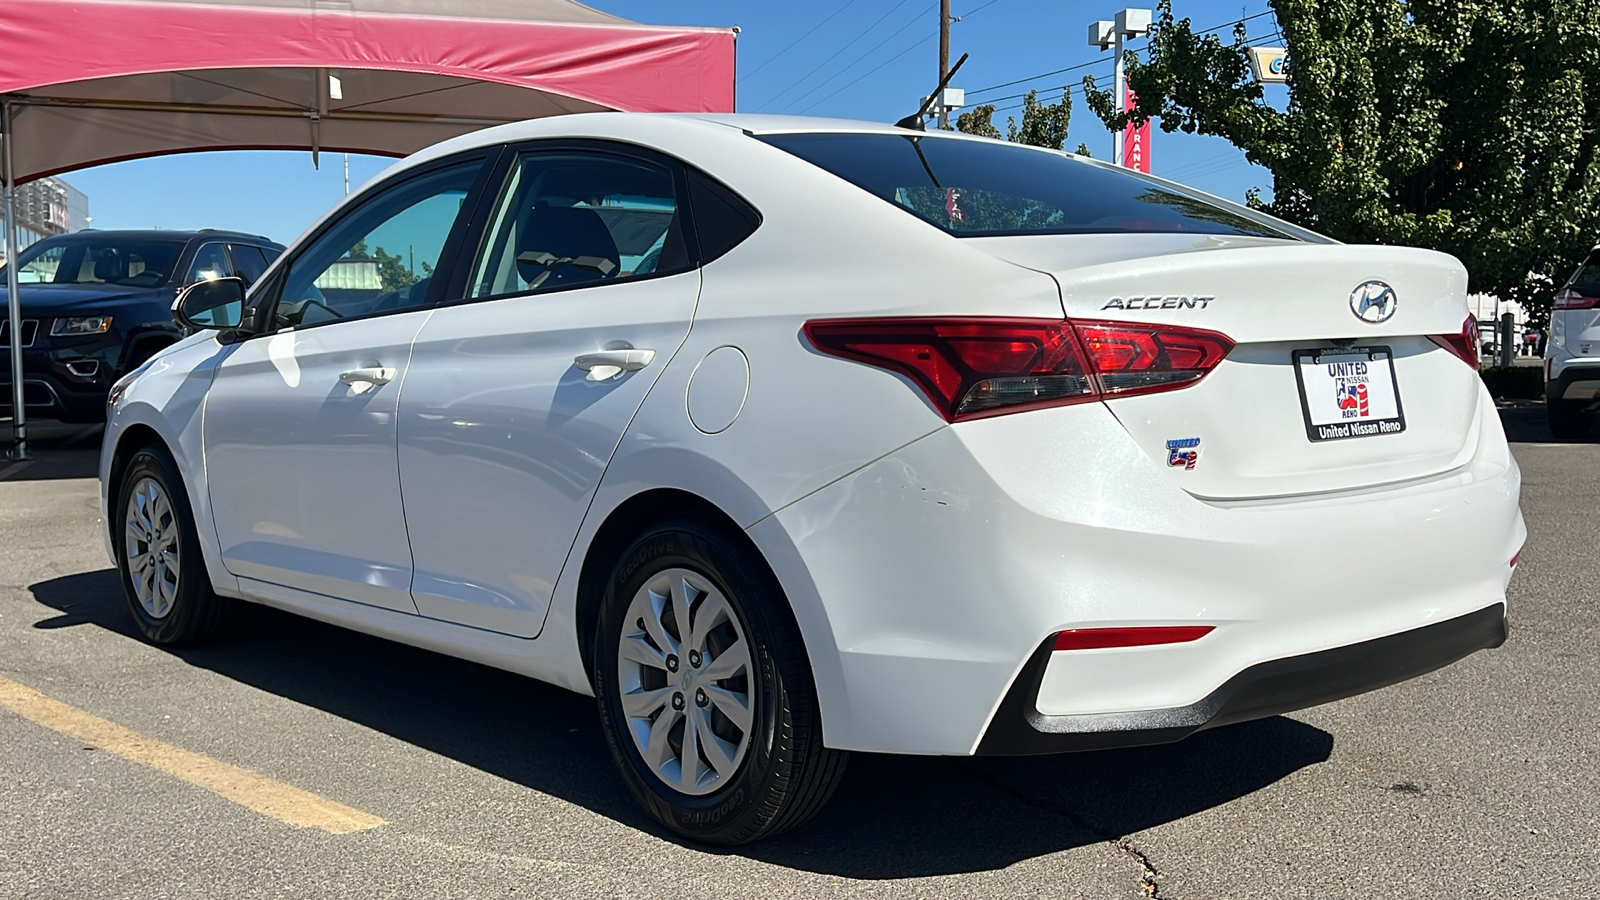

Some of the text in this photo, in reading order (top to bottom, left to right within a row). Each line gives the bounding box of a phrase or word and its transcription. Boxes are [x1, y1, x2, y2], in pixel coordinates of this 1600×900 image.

[1101, 296, 1215, 311] ACCENT
[1328, 363, 1367, 377] UNITED
[1346, 376, 1369, 384] NISSAN
[1342, 410, 1358, 419] RENO
[1318, 421, 1401, 439] United Nissan Reno
[1166, 437, 1201, 449] UNITED
[619, 541, 674, 584] GeoDrive
[681, 787, 744, 826] GeoDrive
